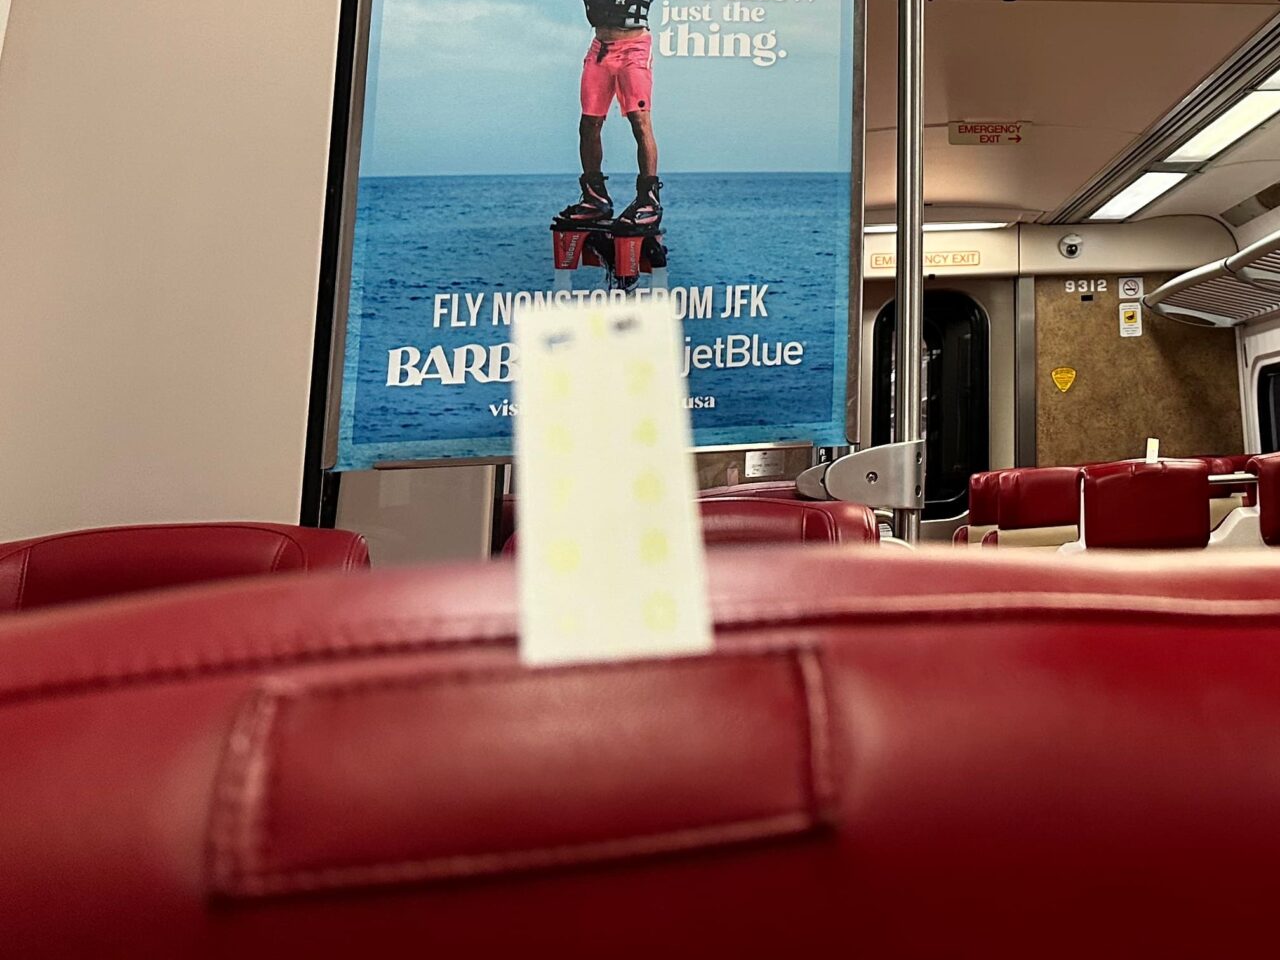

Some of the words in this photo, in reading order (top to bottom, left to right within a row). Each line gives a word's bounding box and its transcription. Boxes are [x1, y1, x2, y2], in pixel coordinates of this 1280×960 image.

[660, 1, 712, 27] just
[722, 0, 766, 23] the
[658, 23, 788, 68] thing.
[958, 124, 1022, 134] EMERGENCY
[979, 134, 1001, 144] EXIT
[874, 254, 949, 266] EMNCY
[952, 253, 976, 264] EXIT
[1065, 279, 1108, 293] 9312
[433, 292, 485, 328] FLY
[720, 284, 770, 319] JFK
[385, 342, 520, 387] BARB
[680, 333, 804, 378] jetBlue
